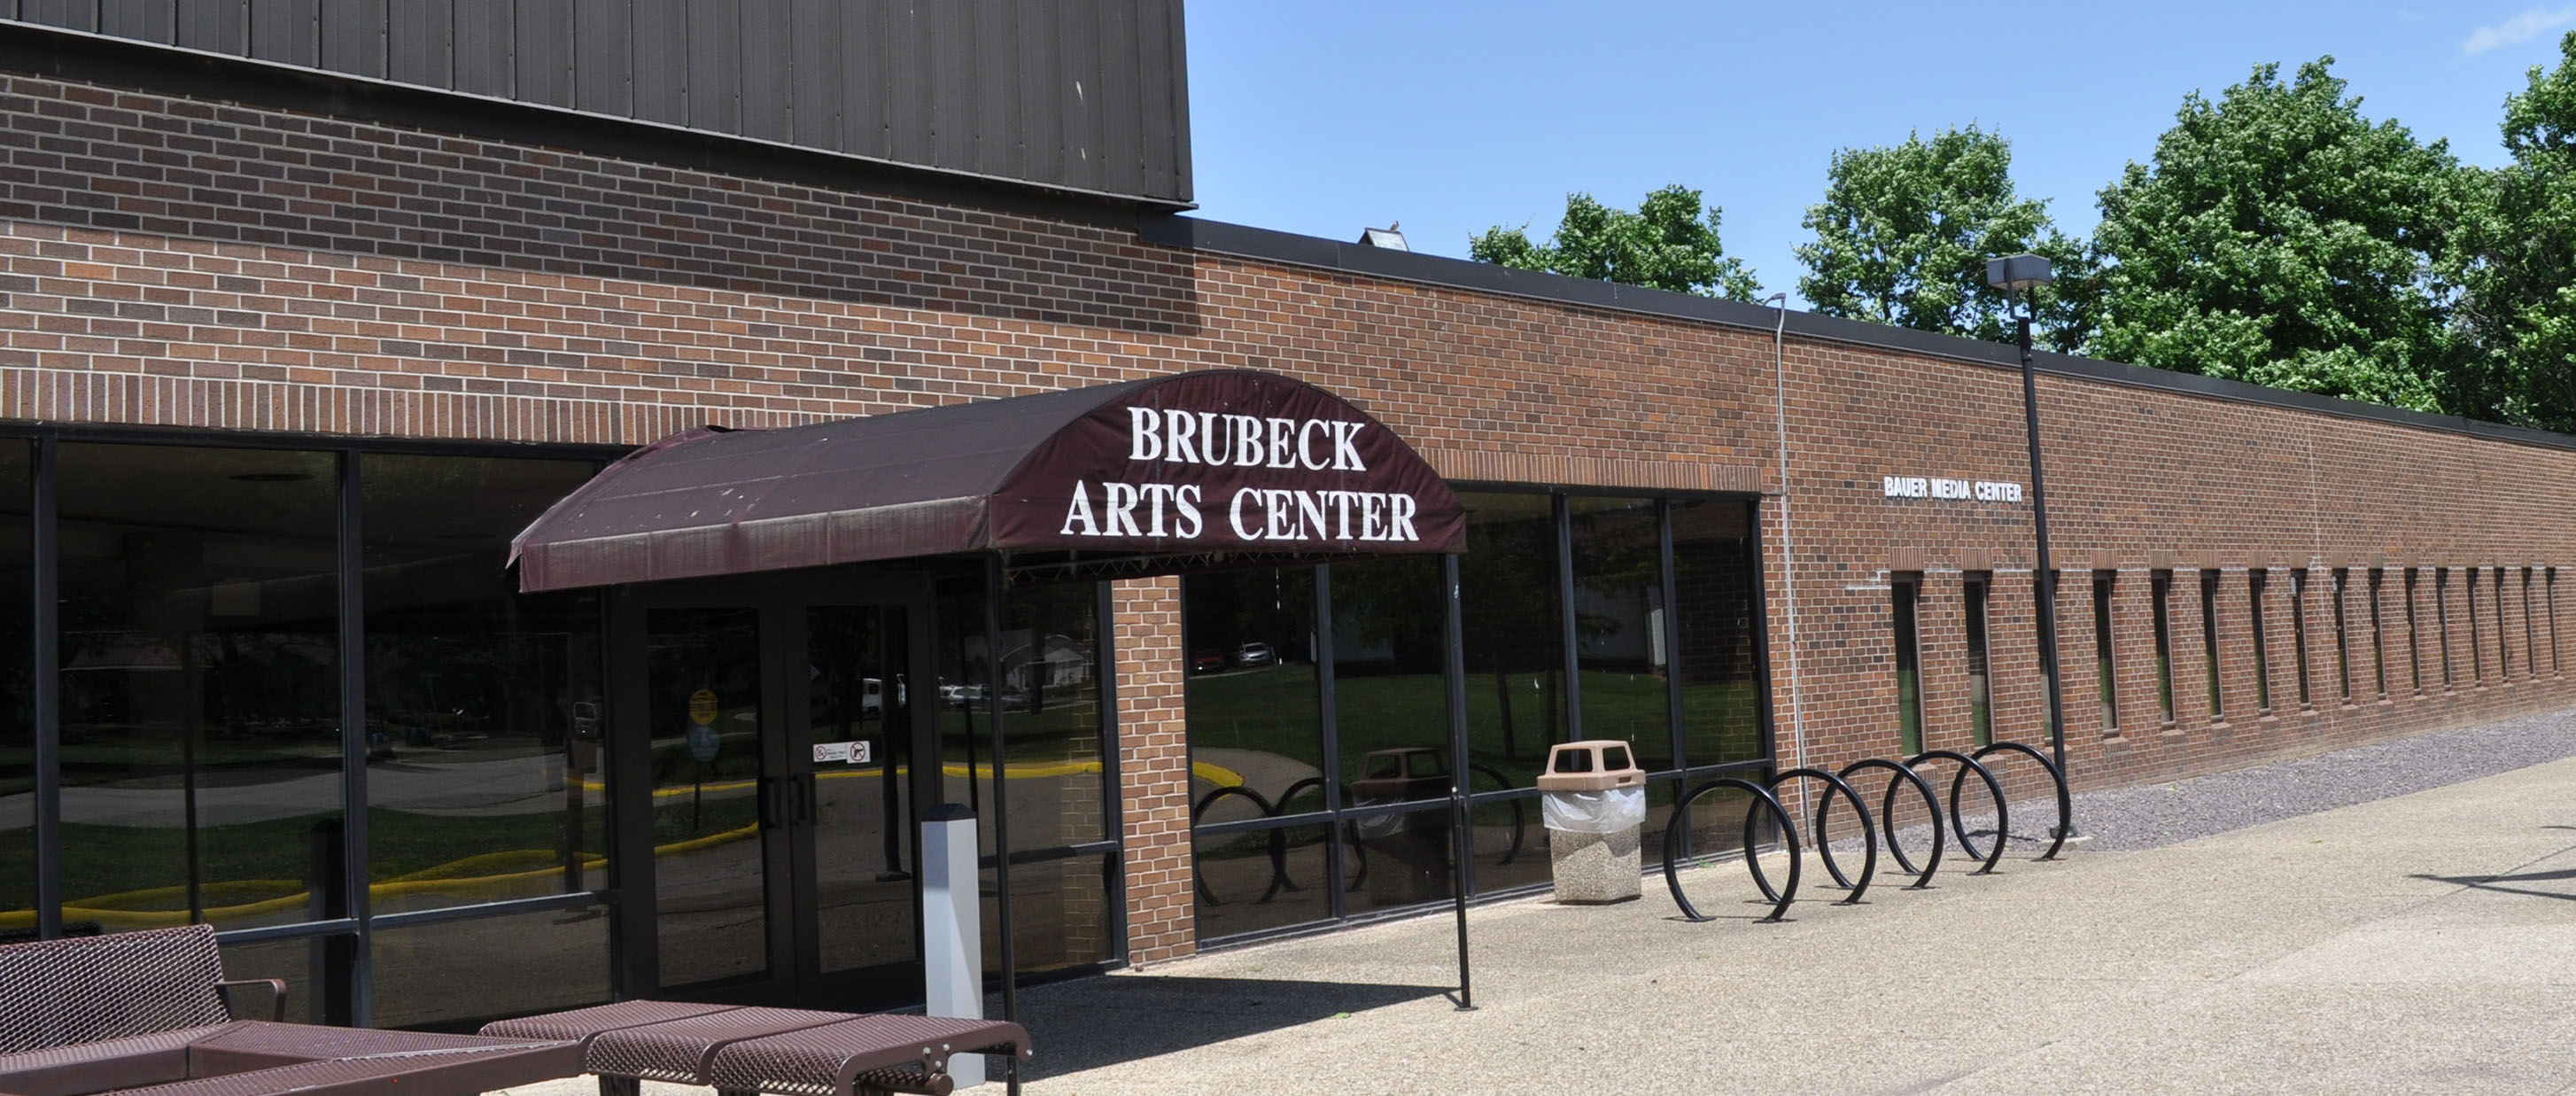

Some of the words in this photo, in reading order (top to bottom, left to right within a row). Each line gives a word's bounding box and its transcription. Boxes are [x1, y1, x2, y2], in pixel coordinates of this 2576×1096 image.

[1127, 406, 1367, 472] BRUBECK
[1059, 479, 1204, 540] ARTS
[1229, 486, 1420, 542] CENTER
[1883, 476, 1928, 498] BAUER
[1930, 478, 1971, 500] MEDIA
[1975, 480, 2022, 502] CENTER
